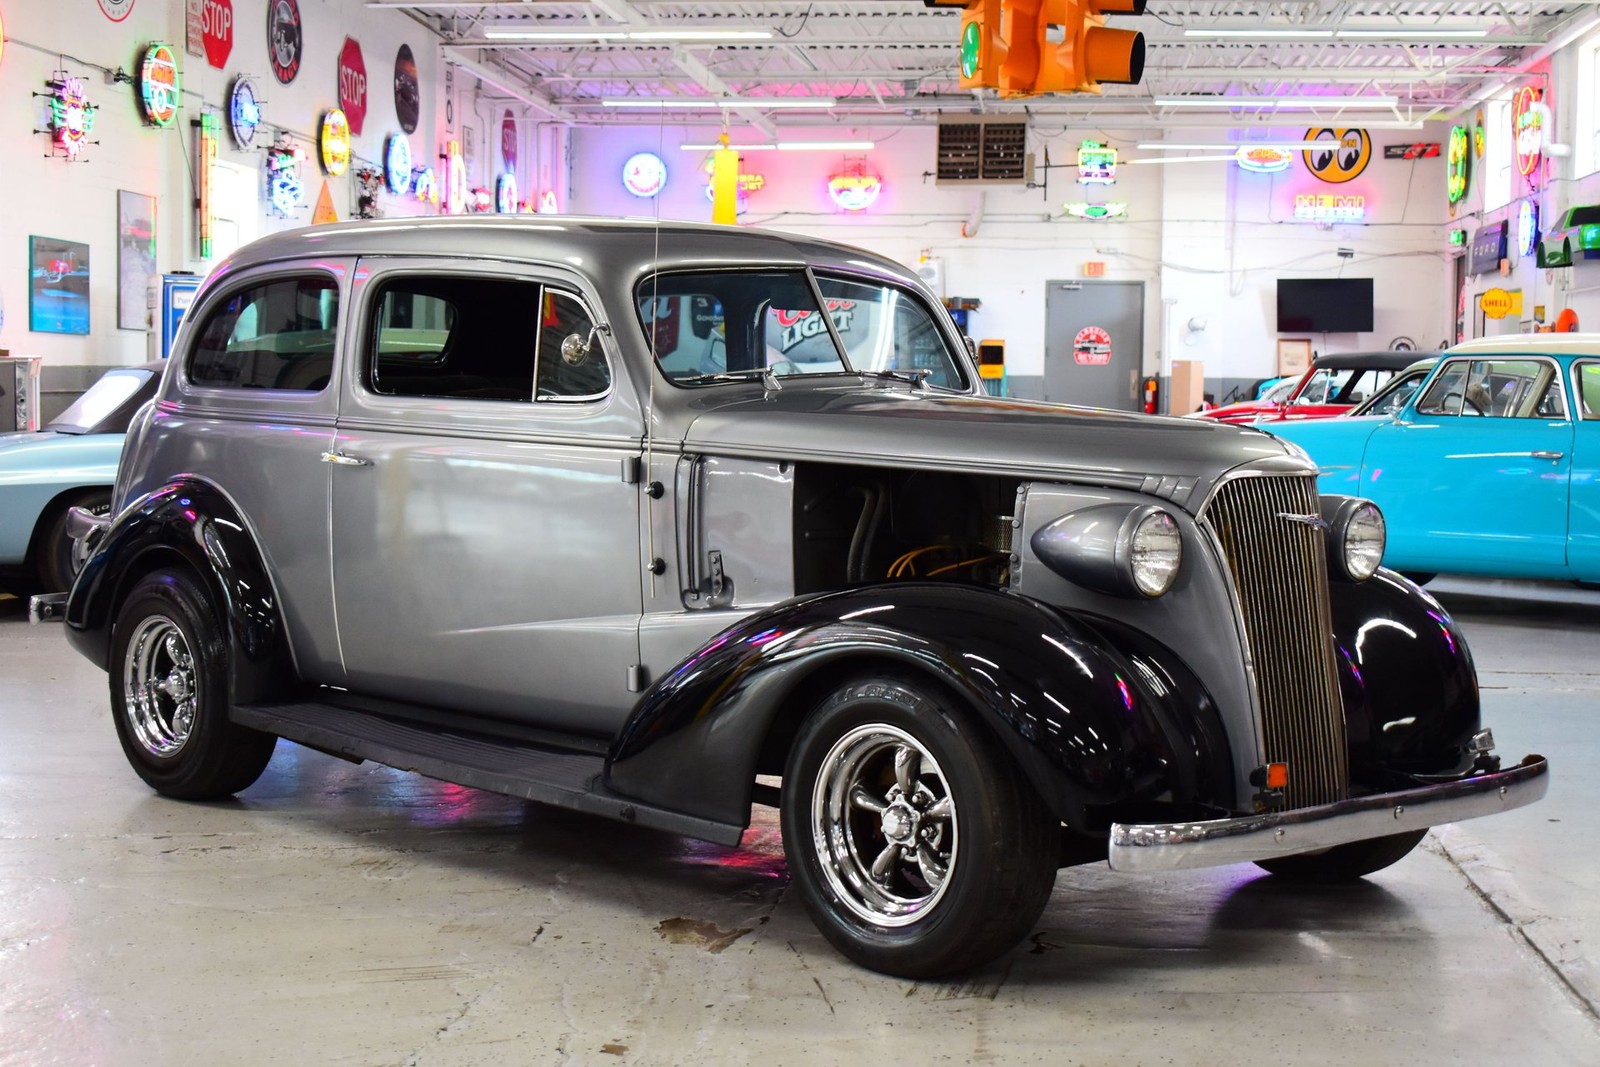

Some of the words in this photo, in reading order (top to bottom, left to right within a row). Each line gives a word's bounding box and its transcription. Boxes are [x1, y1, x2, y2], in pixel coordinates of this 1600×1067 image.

[203, 0, 231, 41] STOP
[341, 66, 366, 107] STOP
[1296, 195, 1365, 209] HEMI
[1474, 243, 1497, 257] FORD
[1087, 262, 1105, 276] EXIT
[1484, 300, 1508, 308] SHELL
